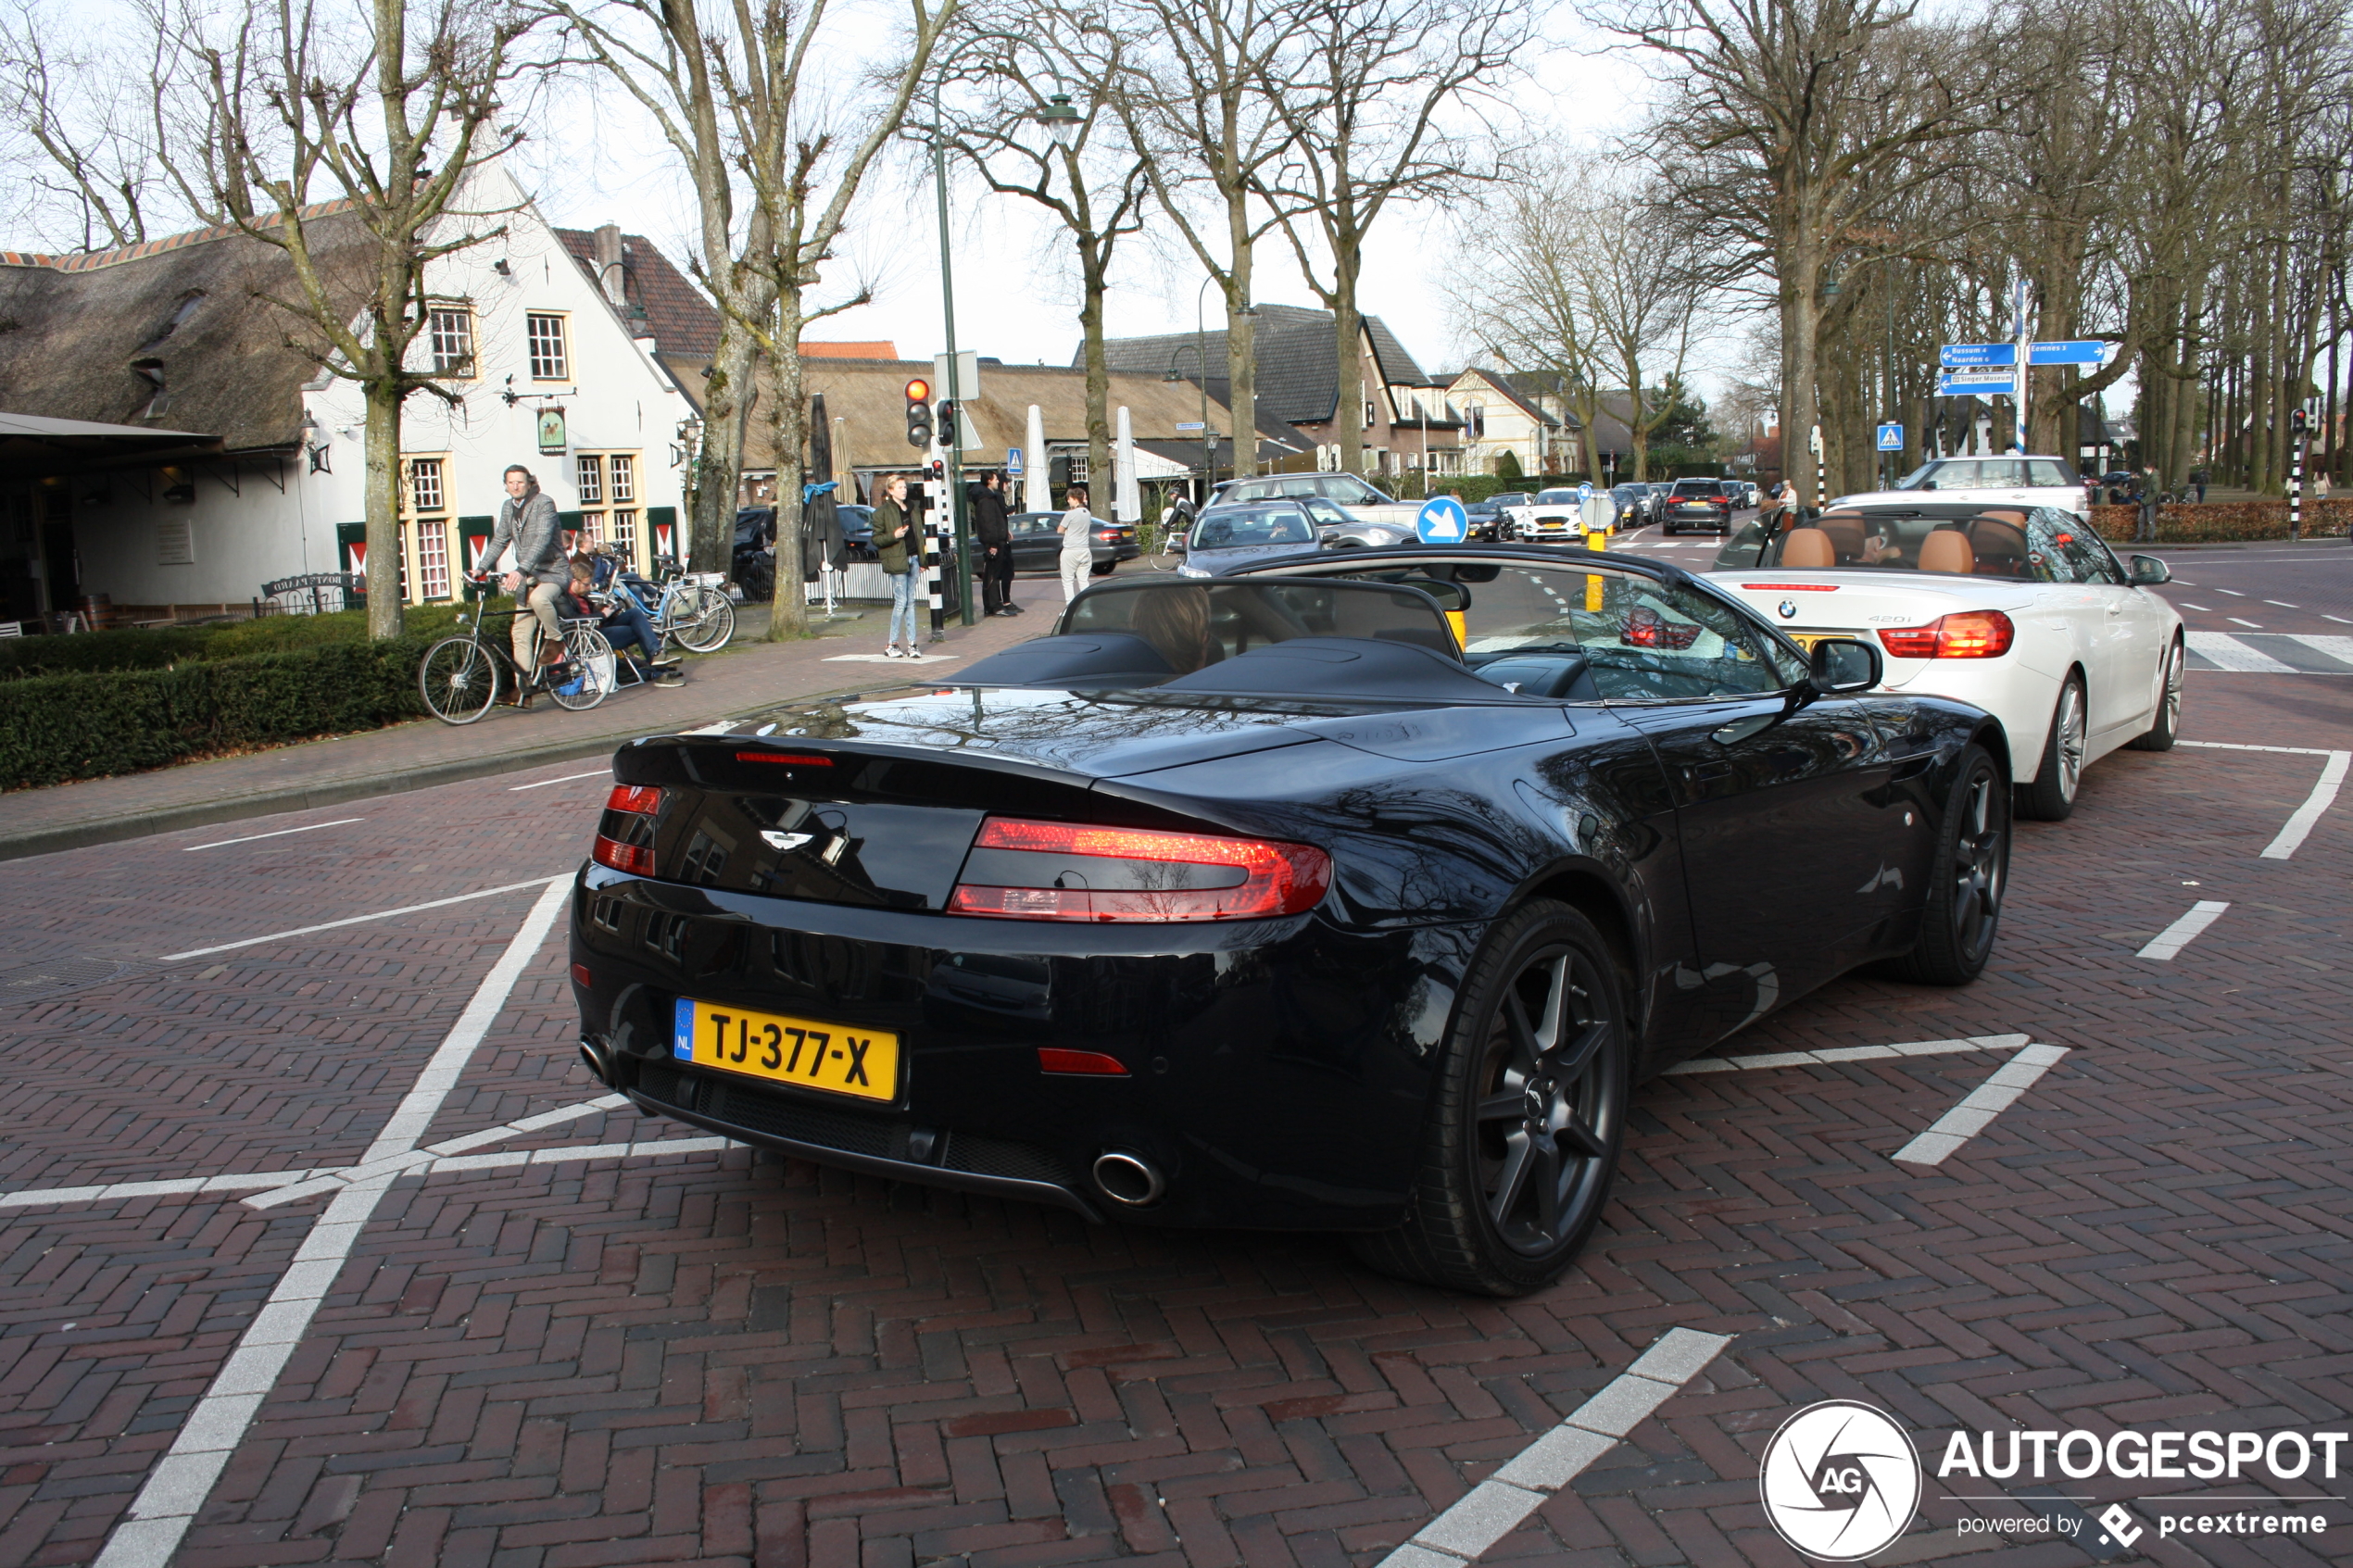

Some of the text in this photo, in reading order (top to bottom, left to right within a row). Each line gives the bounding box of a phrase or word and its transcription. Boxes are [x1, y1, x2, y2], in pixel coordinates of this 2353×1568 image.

[1868, 615, 1912, 623] 420i
[677, 1035, 691, 1050] NL
[710, 1012, 872, 1088] TJ-377-X
